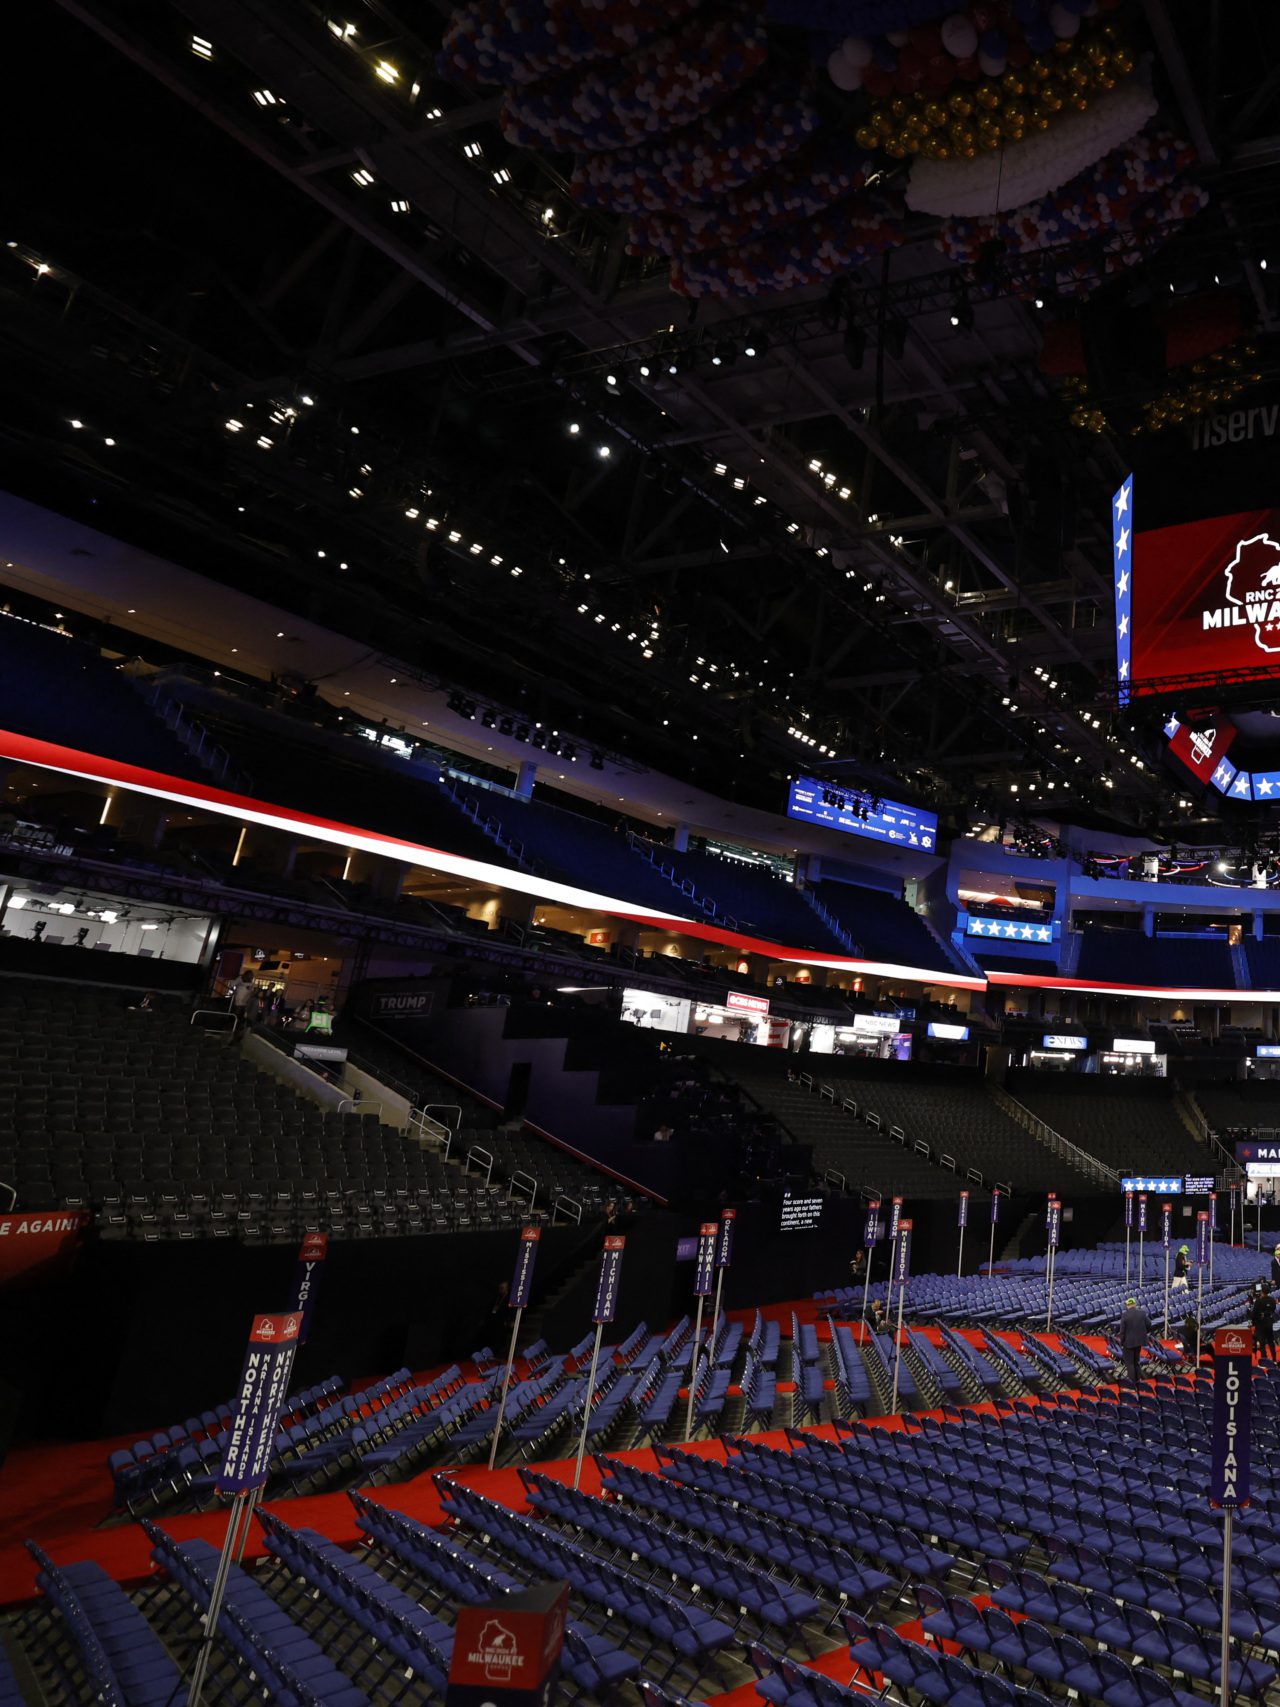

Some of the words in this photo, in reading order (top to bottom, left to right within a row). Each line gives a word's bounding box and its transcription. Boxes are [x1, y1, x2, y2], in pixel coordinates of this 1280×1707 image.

[1245, 589, 1275, 603] RNC
[380, 996, 426, 1009] TRUMP
[879, 1021, 896, 1029] NEWS
[16, 1217, 80, 1234] AGAIN!
[720, 1219, 731, 1263] OKLAHOMA
[892, 1204, 900, 1237] OREGON
[517, 1241, 533, 1303] MISSISSIPPI
[705, 1236, 715, 1290] HAWAII
[899, 1231, 907, 1280] MINNESOTA
[603, 1251, 619, 1317] MICHIGAN
[252, 1354, 271, 1415] MARIANA
[223, 1353, 260, 1478] NORTHERN
[251, 1351, 285, 1477] NORTHERN
[1223, 1361, 1240, 1498] LOUISIANA
[237, 1419, 255, 1480] ISLANDS
[468, 1652, 524, 1666] MILWAUKEE
